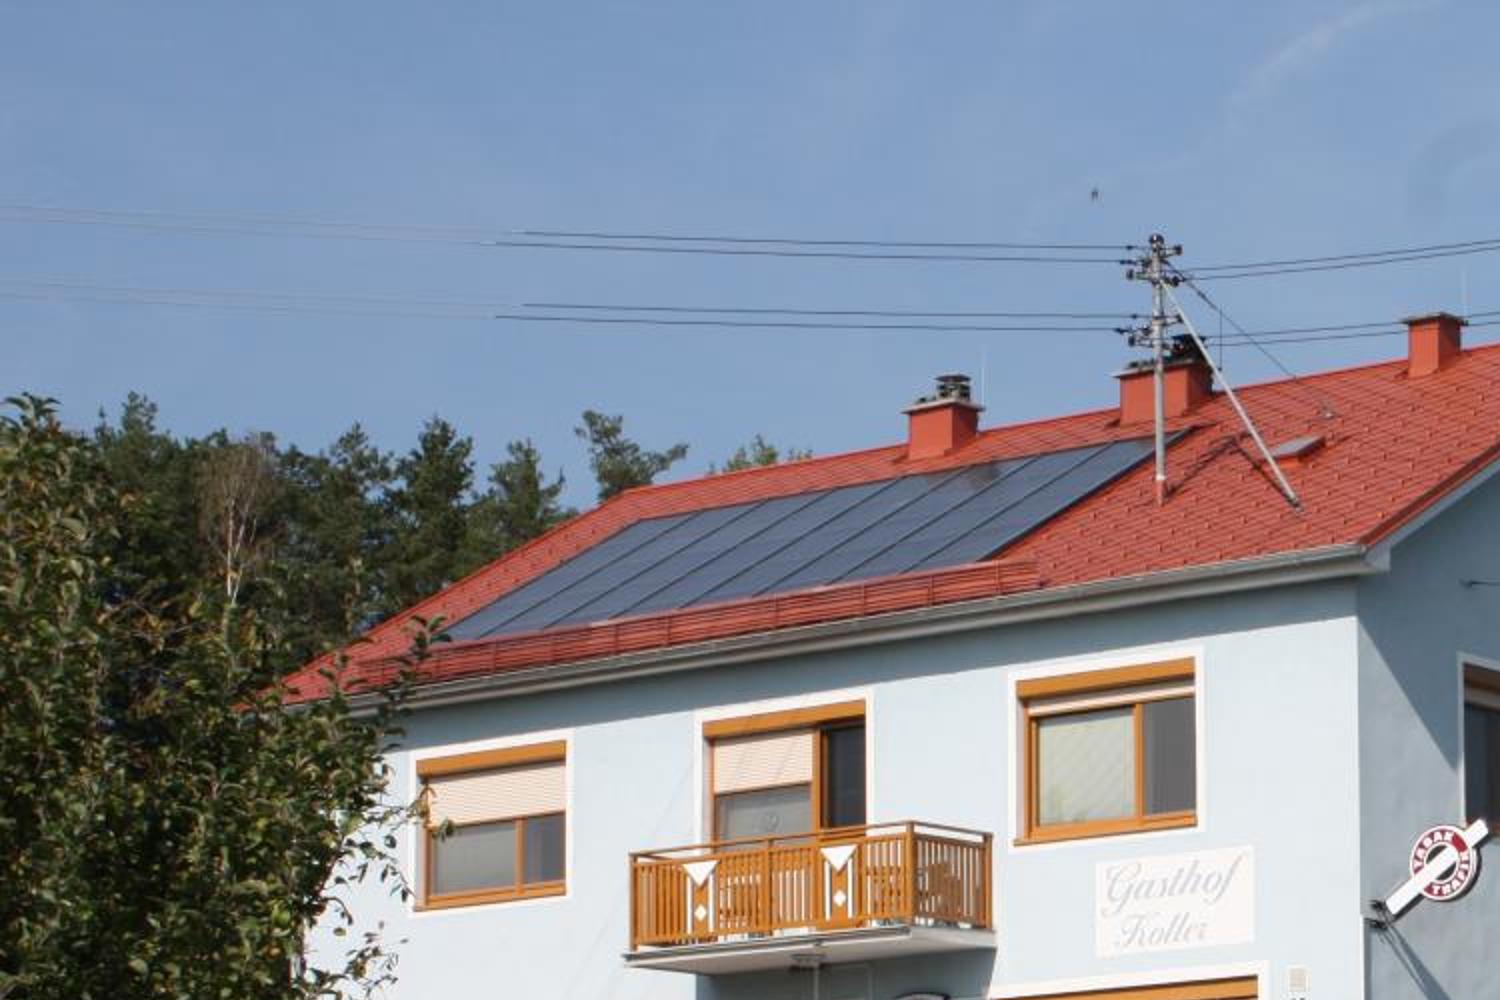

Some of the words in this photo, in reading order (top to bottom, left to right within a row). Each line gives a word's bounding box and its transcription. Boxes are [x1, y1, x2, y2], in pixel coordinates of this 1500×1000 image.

[1412, 830, 1454, 870] TABAK
[1100, 854, 1243, 917] Gasthof
[1431, 850, 1470, 897] TRAFIK
[1114, 911, 1209, 947] Koller
